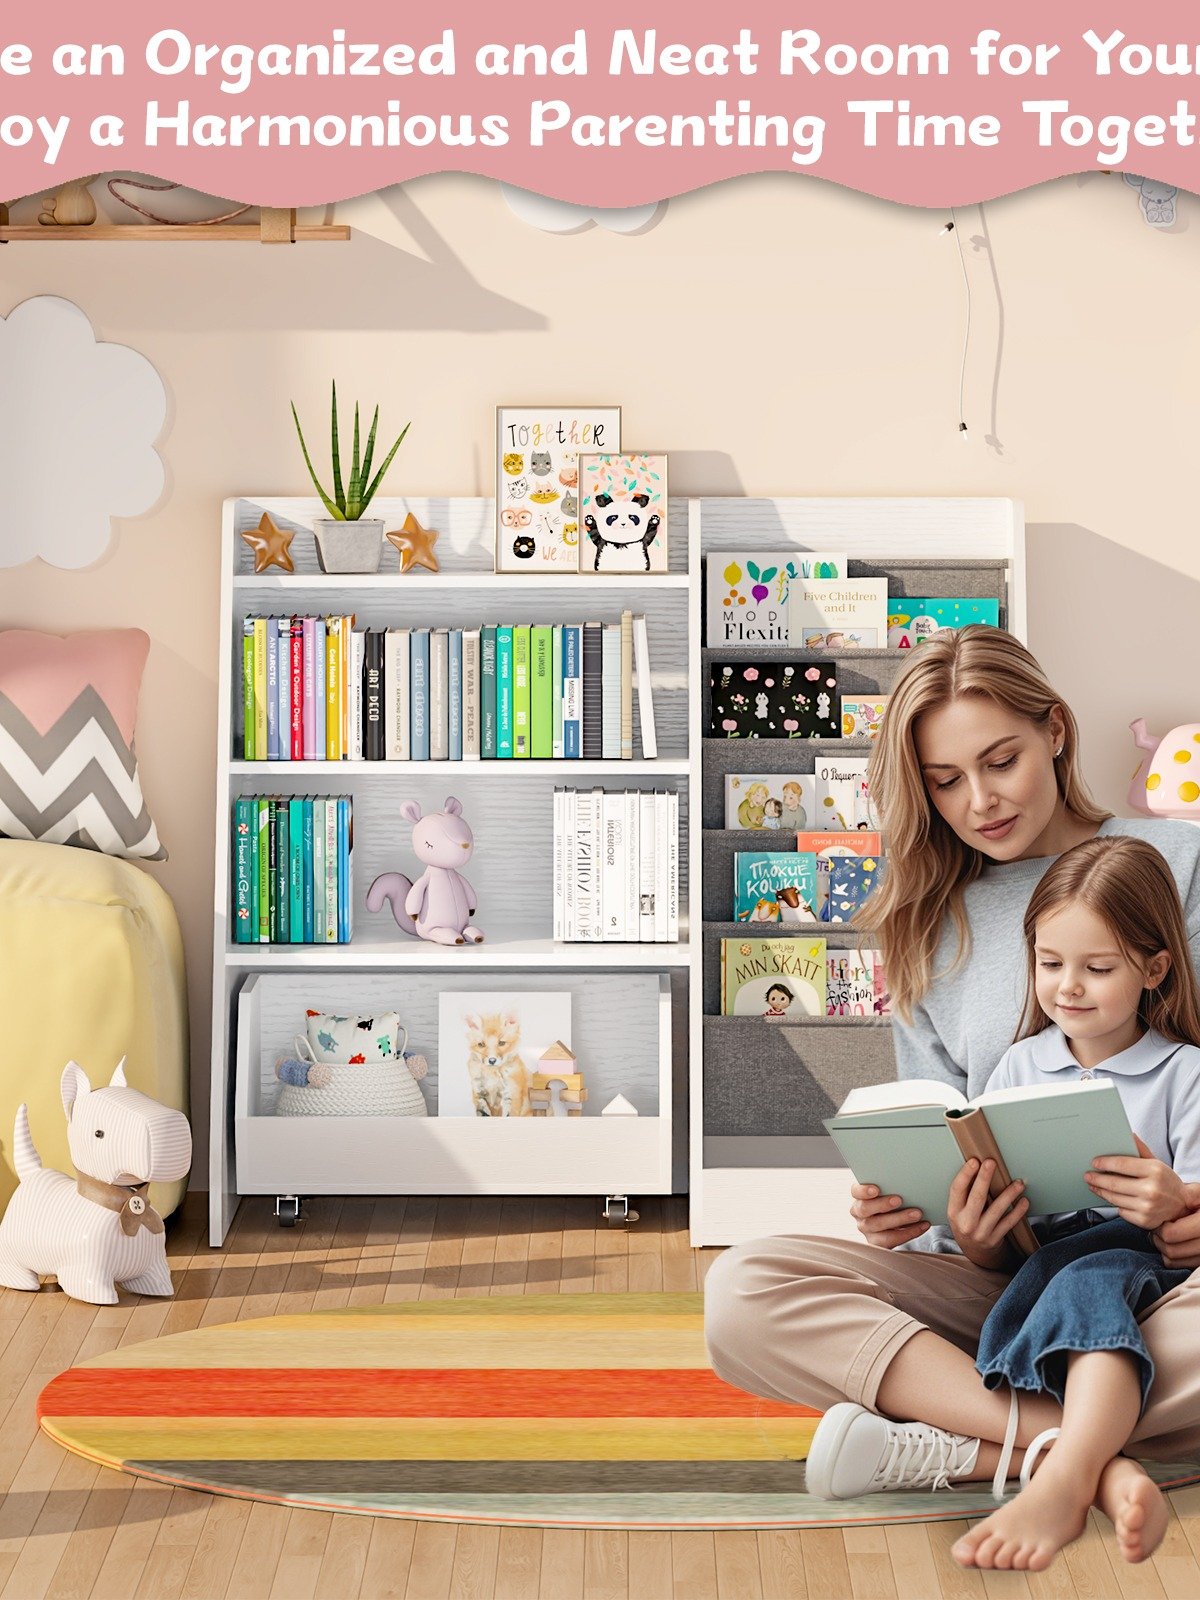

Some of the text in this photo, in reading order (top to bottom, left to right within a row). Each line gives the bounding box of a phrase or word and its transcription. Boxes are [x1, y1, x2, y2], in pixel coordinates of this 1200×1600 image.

[804, 592, 877, 600] Five Children
[824, 603, 856, 612] and It
[567, 631, 575, 640] THE
[915, 622, 931, 630] Baby
[466, 640, 475, 666] TOLSTOY
[567, 640, 575, 656] PALEO
[415, 658, 425, 687] art
[483, 661, 494, 676] RIGBY
[280, 679, 288, 709] Design
[368, 669, 379, 722] ART DECO
[292, 708, 300, 732] Design
[821, 768, 828, 780] O
[238, 837, 249, 905] Hansel and Gretel
[761, 944, 795, 955] Du och jag
[735, 954, 823, 984] MIN SKATT
[826, 986, 872, 1011] fashion
